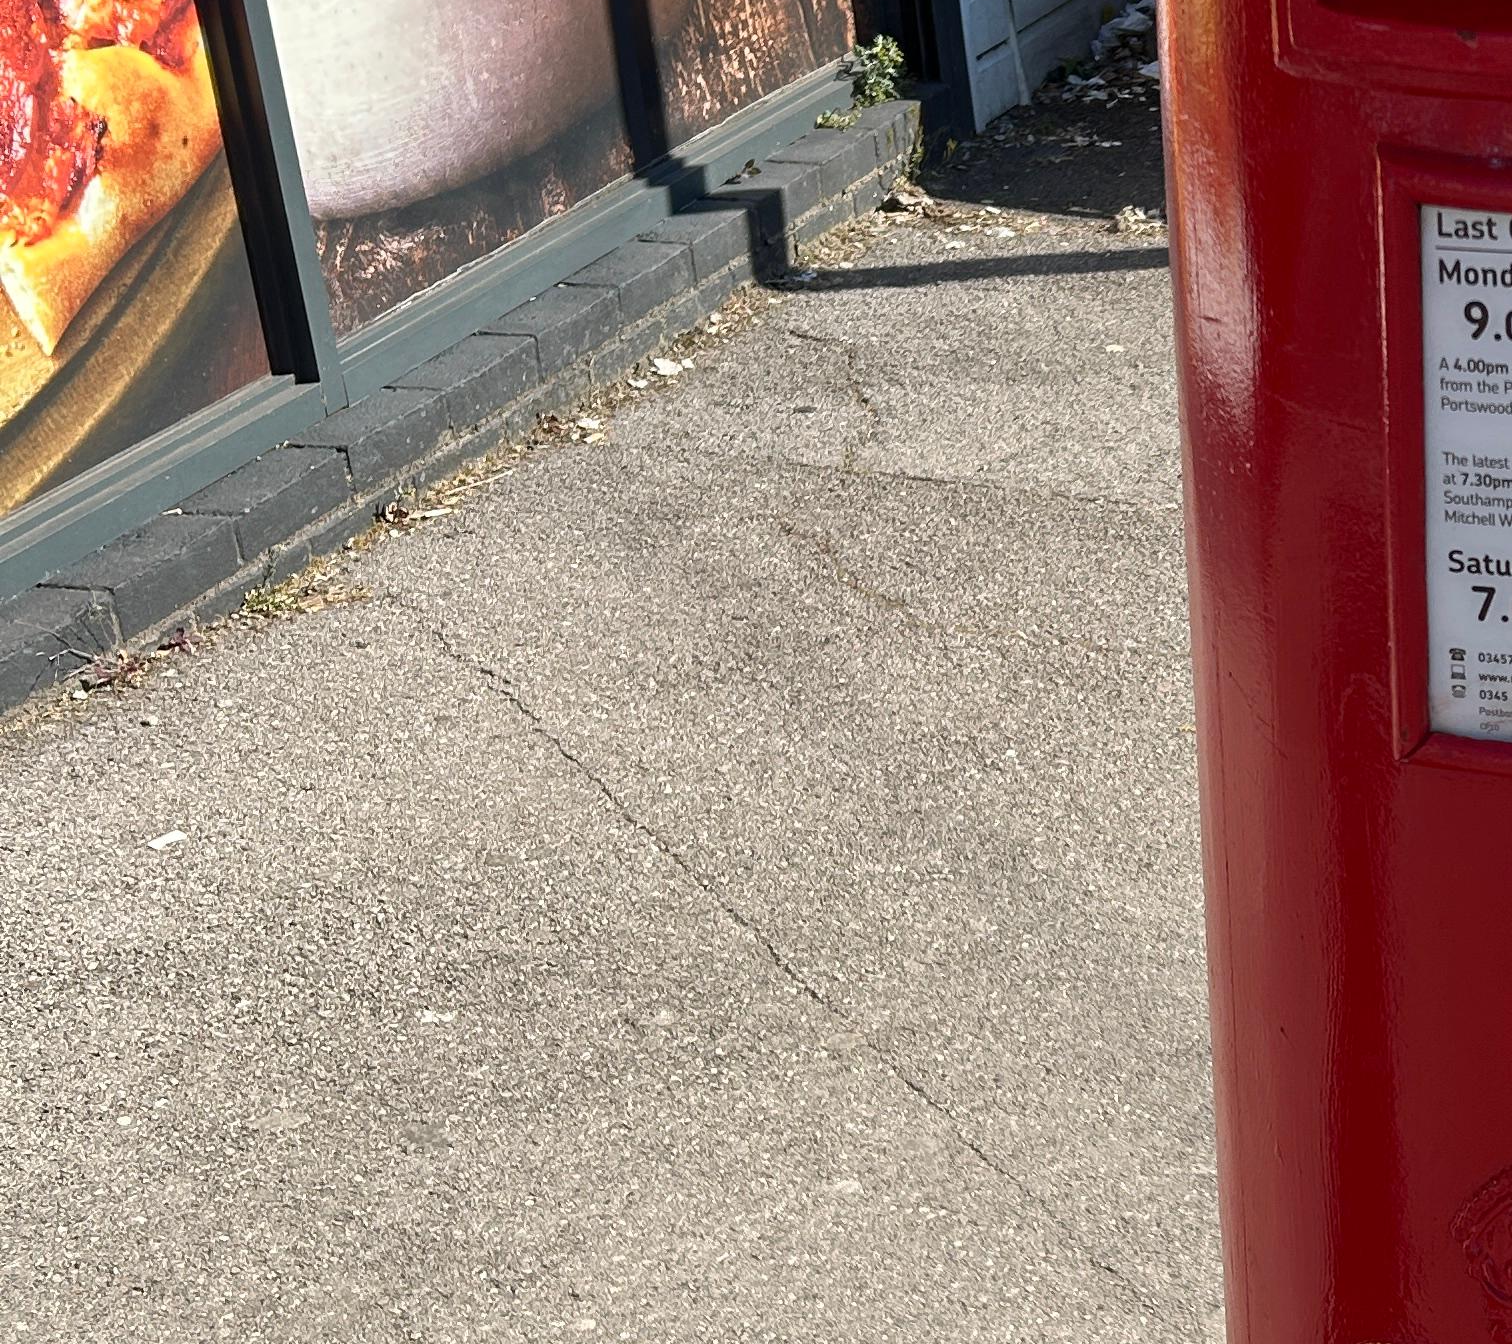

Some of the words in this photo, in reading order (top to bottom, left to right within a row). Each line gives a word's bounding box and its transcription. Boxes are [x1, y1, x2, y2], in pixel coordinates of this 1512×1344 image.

[1437, 212, 1499, 241] Last
[1438, 357, 1449, 371] A
[1453, 358, 1509, 376] 4.00pm
[1440, 377, 1473, 393] from
[1477, 379, 1500, 395] the
[1442, 451, 1468, 467] The
[1472, 454, 1510, 470] latest
[1443, 472, 1457, 486] at
[1444, 510, 1496, 527] Mitchell
[1479, 689, 1508, 702] 0345
